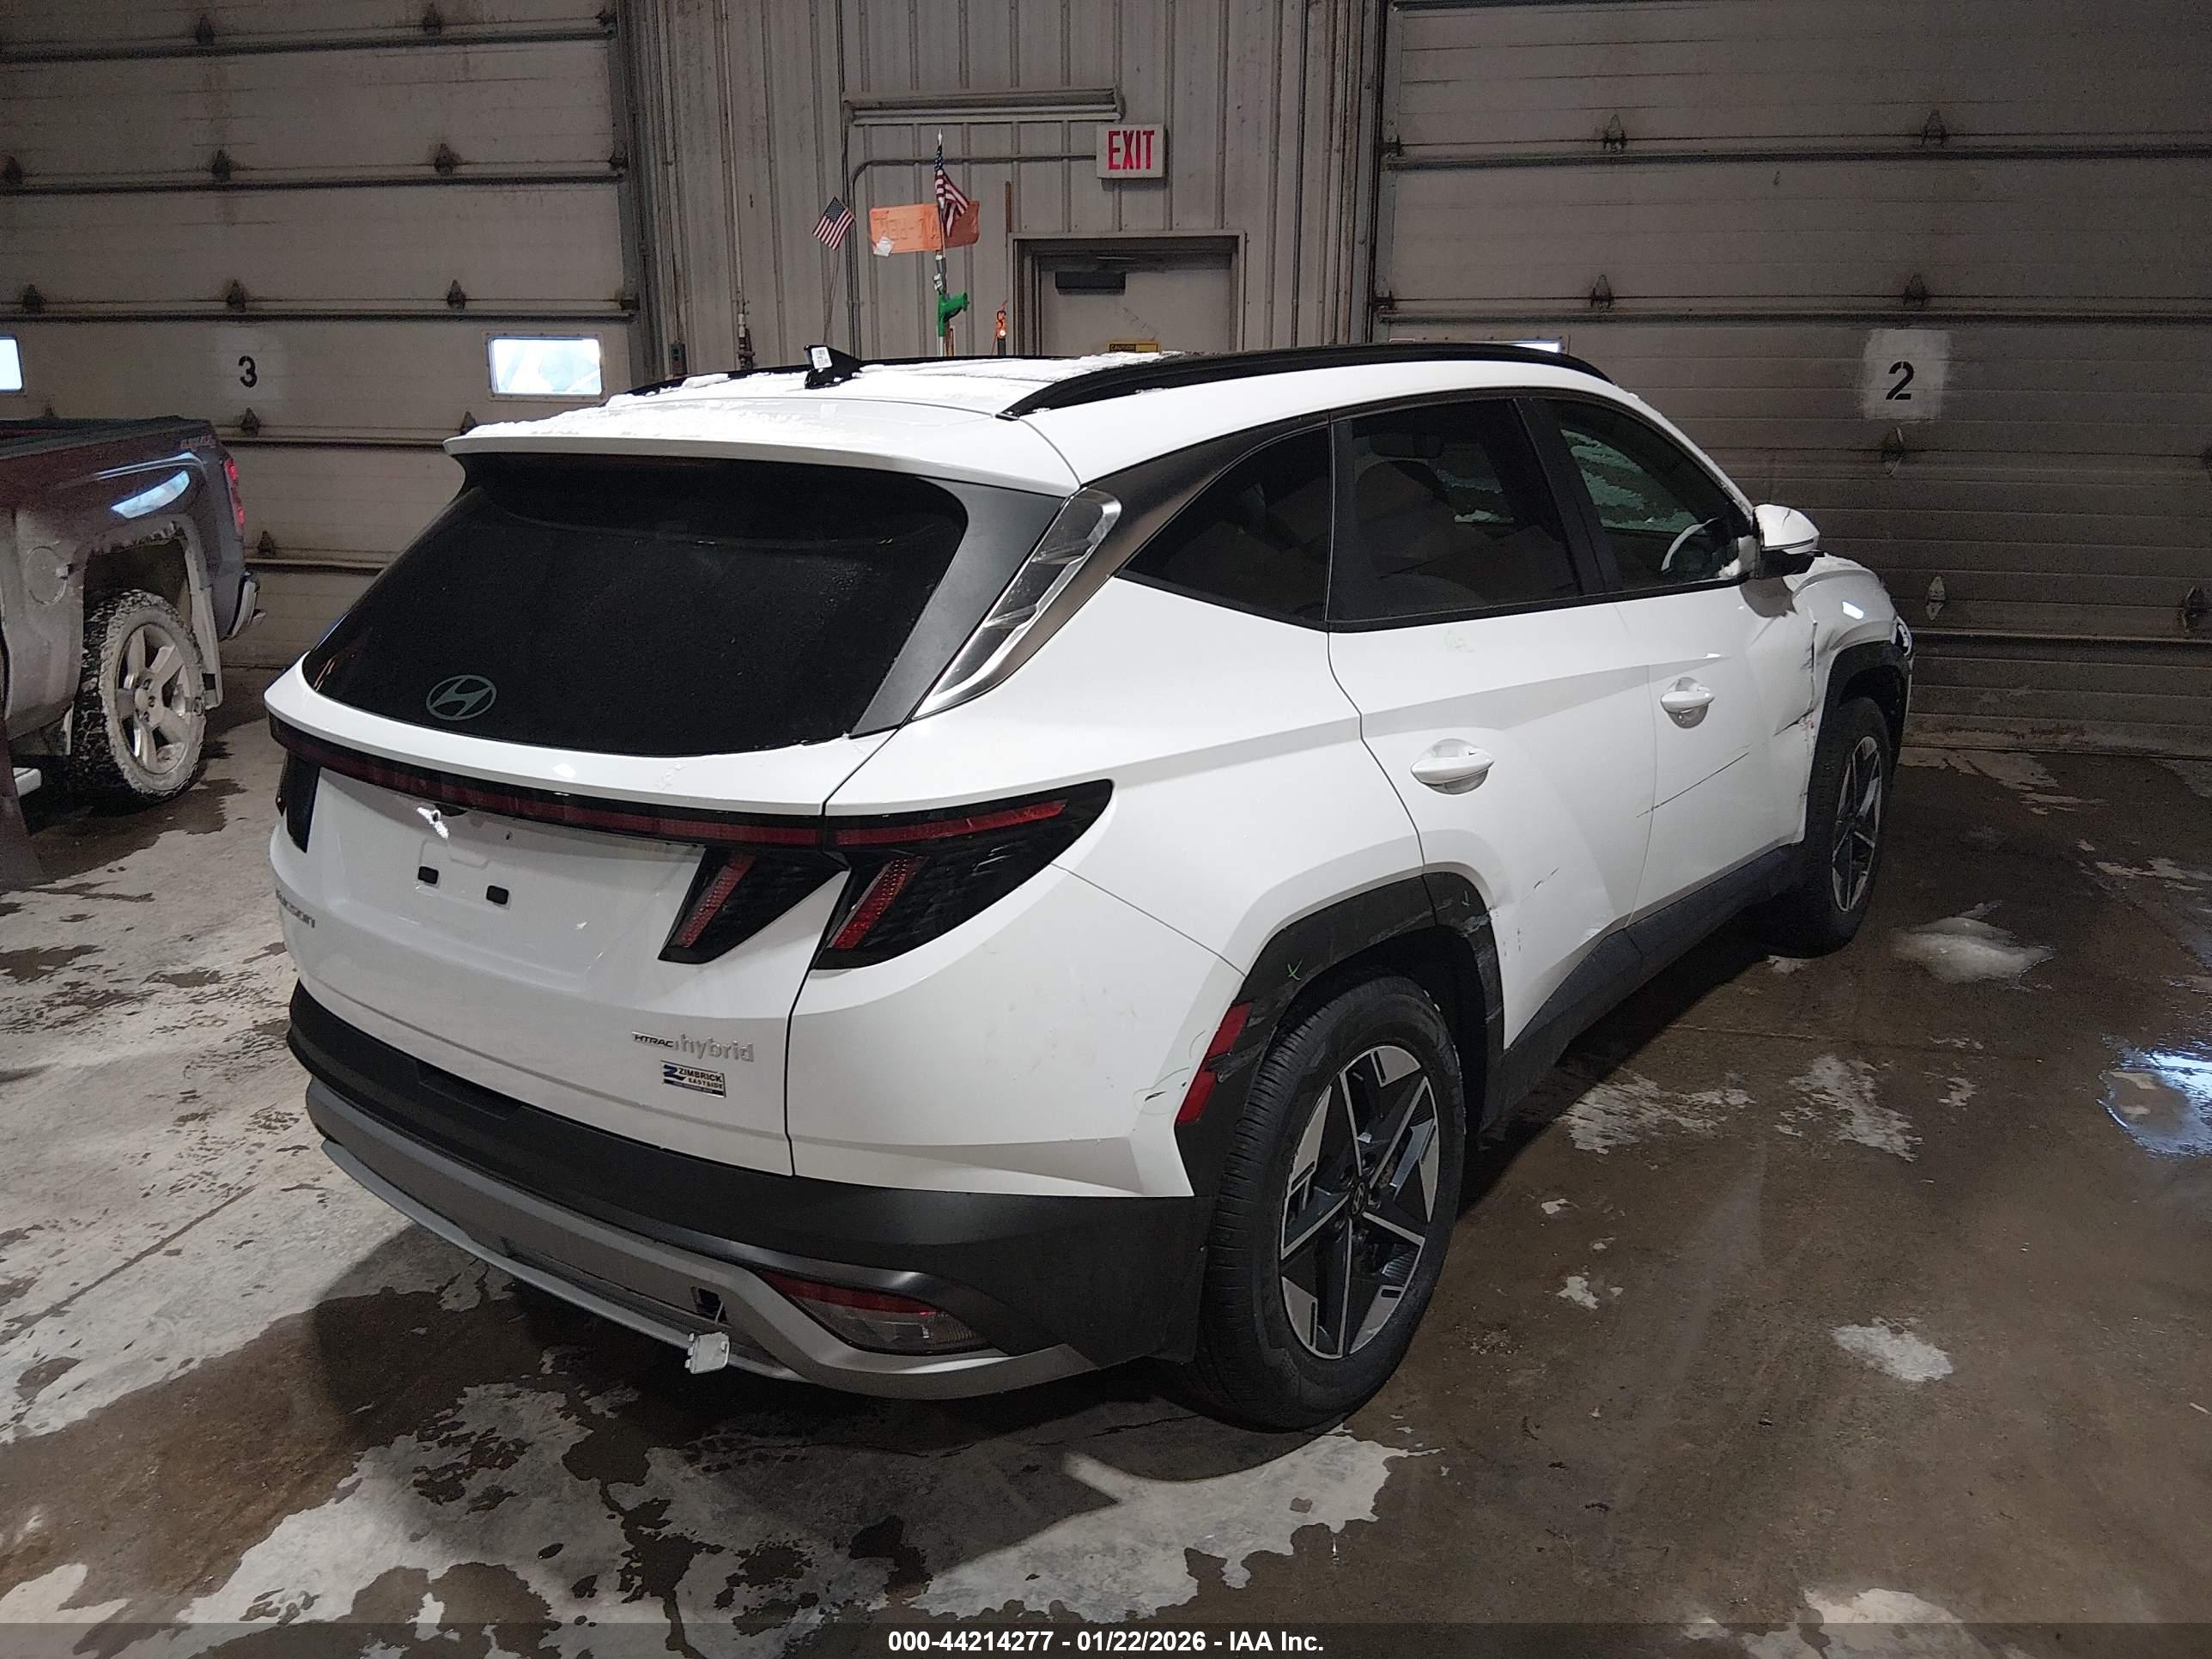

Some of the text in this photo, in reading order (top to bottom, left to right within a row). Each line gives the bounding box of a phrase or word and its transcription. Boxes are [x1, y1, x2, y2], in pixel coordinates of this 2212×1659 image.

[1108, 130, 1155, 170] EXIT
[238, 356, 258, 388] 3
[1885, 361, 1914, 400] 2
[634, 1033, 754, 1062] HTRAC hybrid
[678, 1067, 722, 1083] ZIMBRICK
[688, 1078, 723, 1090] EASTSIDE
